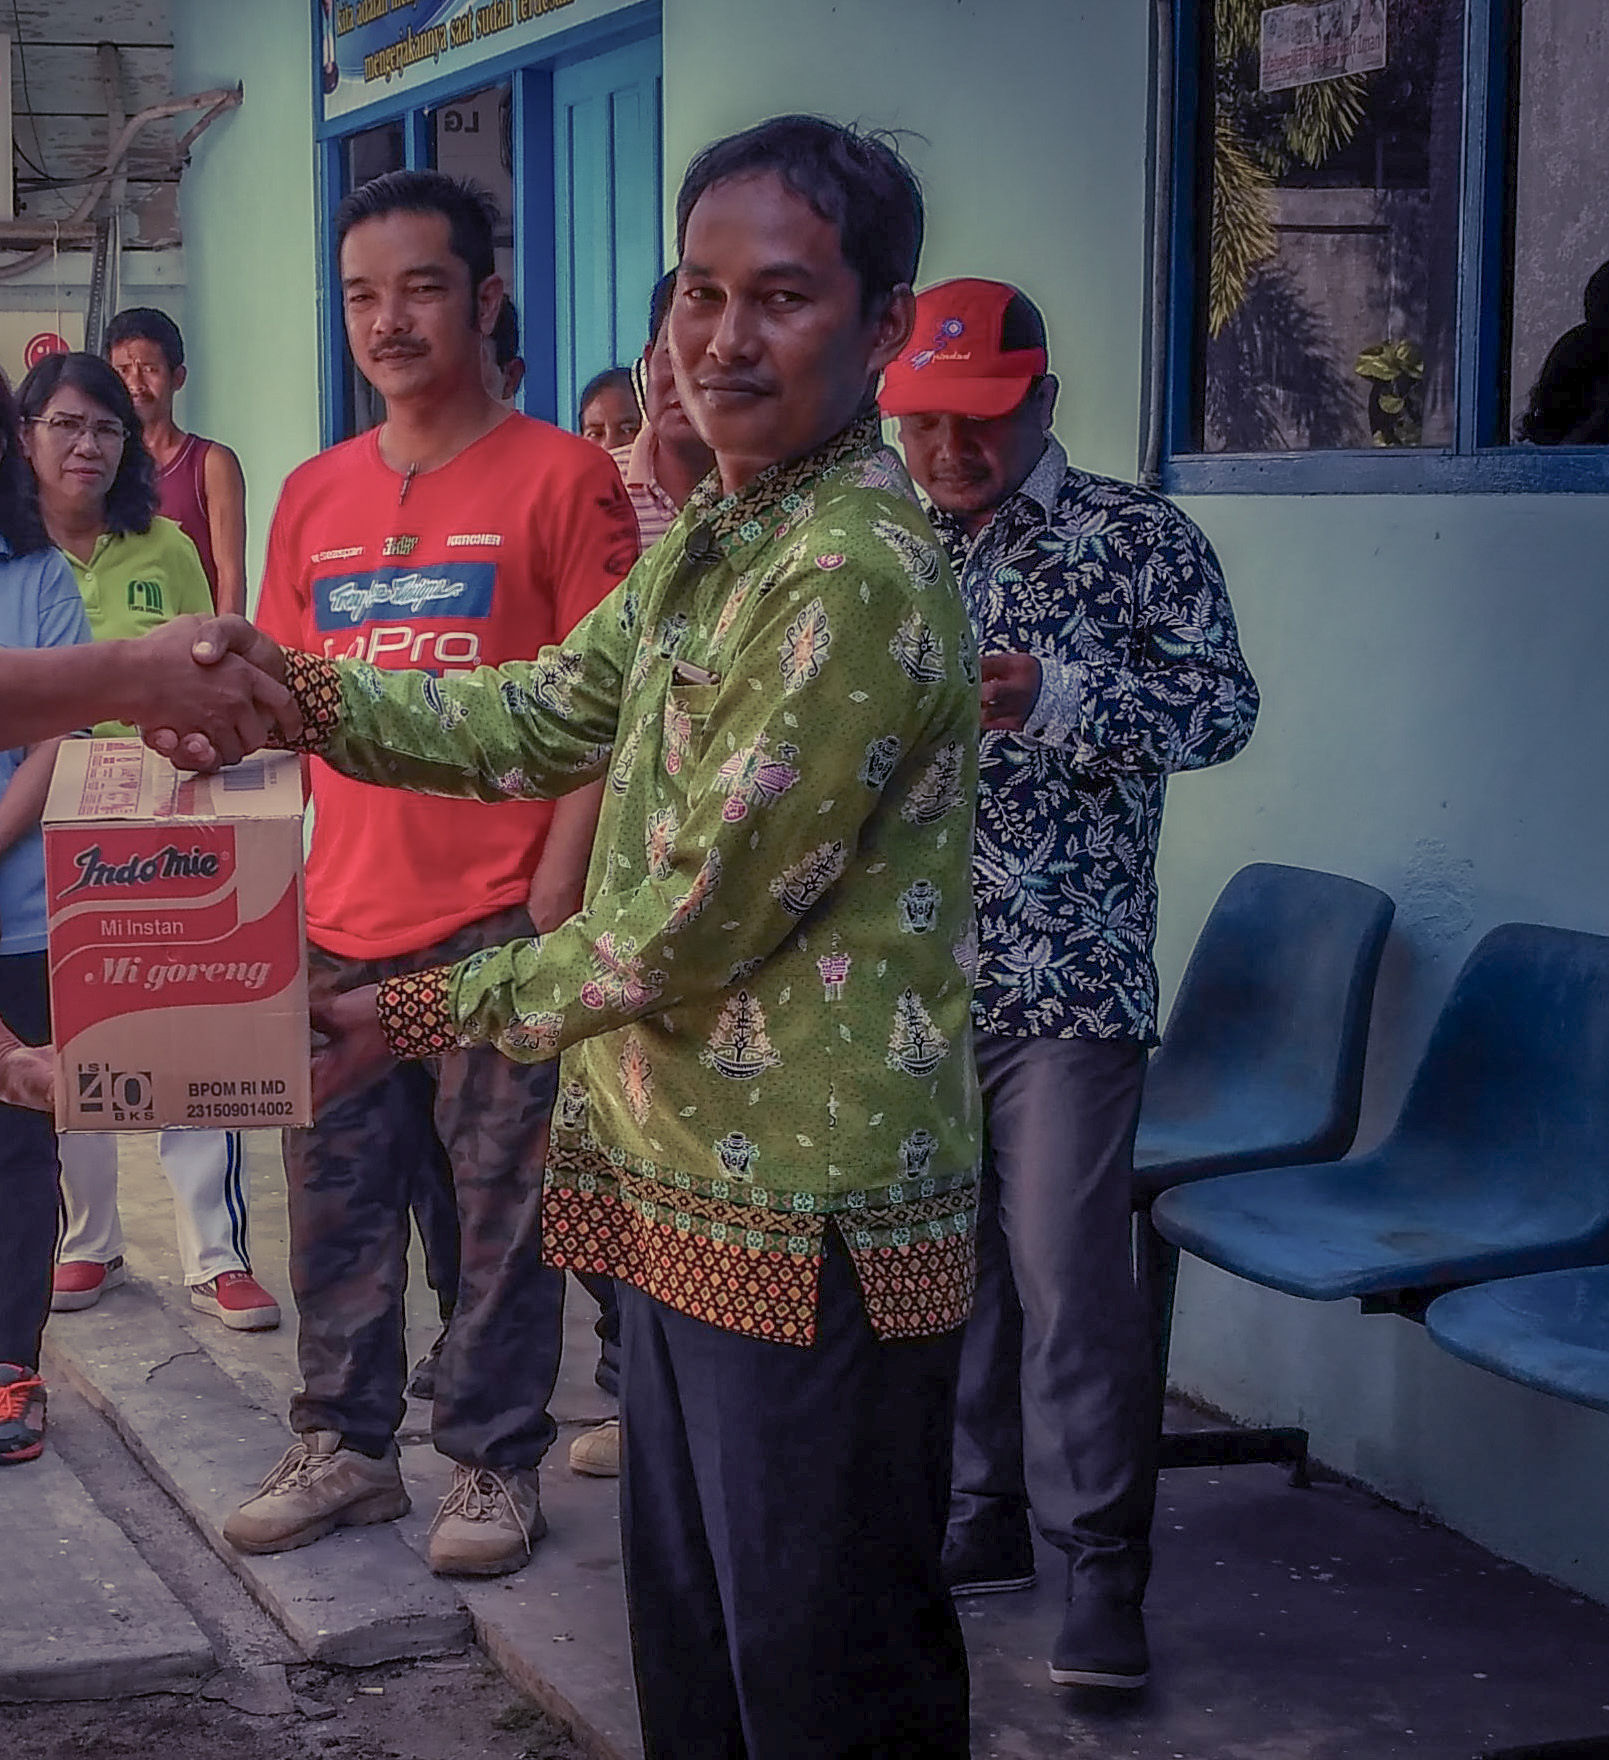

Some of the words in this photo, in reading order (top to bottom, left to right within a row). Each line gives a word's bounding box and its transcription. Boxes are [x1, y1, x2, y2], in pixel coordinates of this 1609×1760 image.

[450, 10, 474, 47] saat
[476, 0, 513, 38] sudah
[101, 920, 122, 936] Mi
[128, 919, 184, 936] Instan
[84, 957, 141, 984] Mi
[144, 960, 271, 991] goreng
[78, 1063, 109, 1072] ISI
[79, 1072, 153, 1112] 40
[188, 1082, 235, 1097] BPOM
[241, 1081, 256, 1095] RI
[261, 1080, 286, 1095] MD
[114, 1112, 155, 1121] BKS
[187, 1101, 294, 1118] 231509014002
